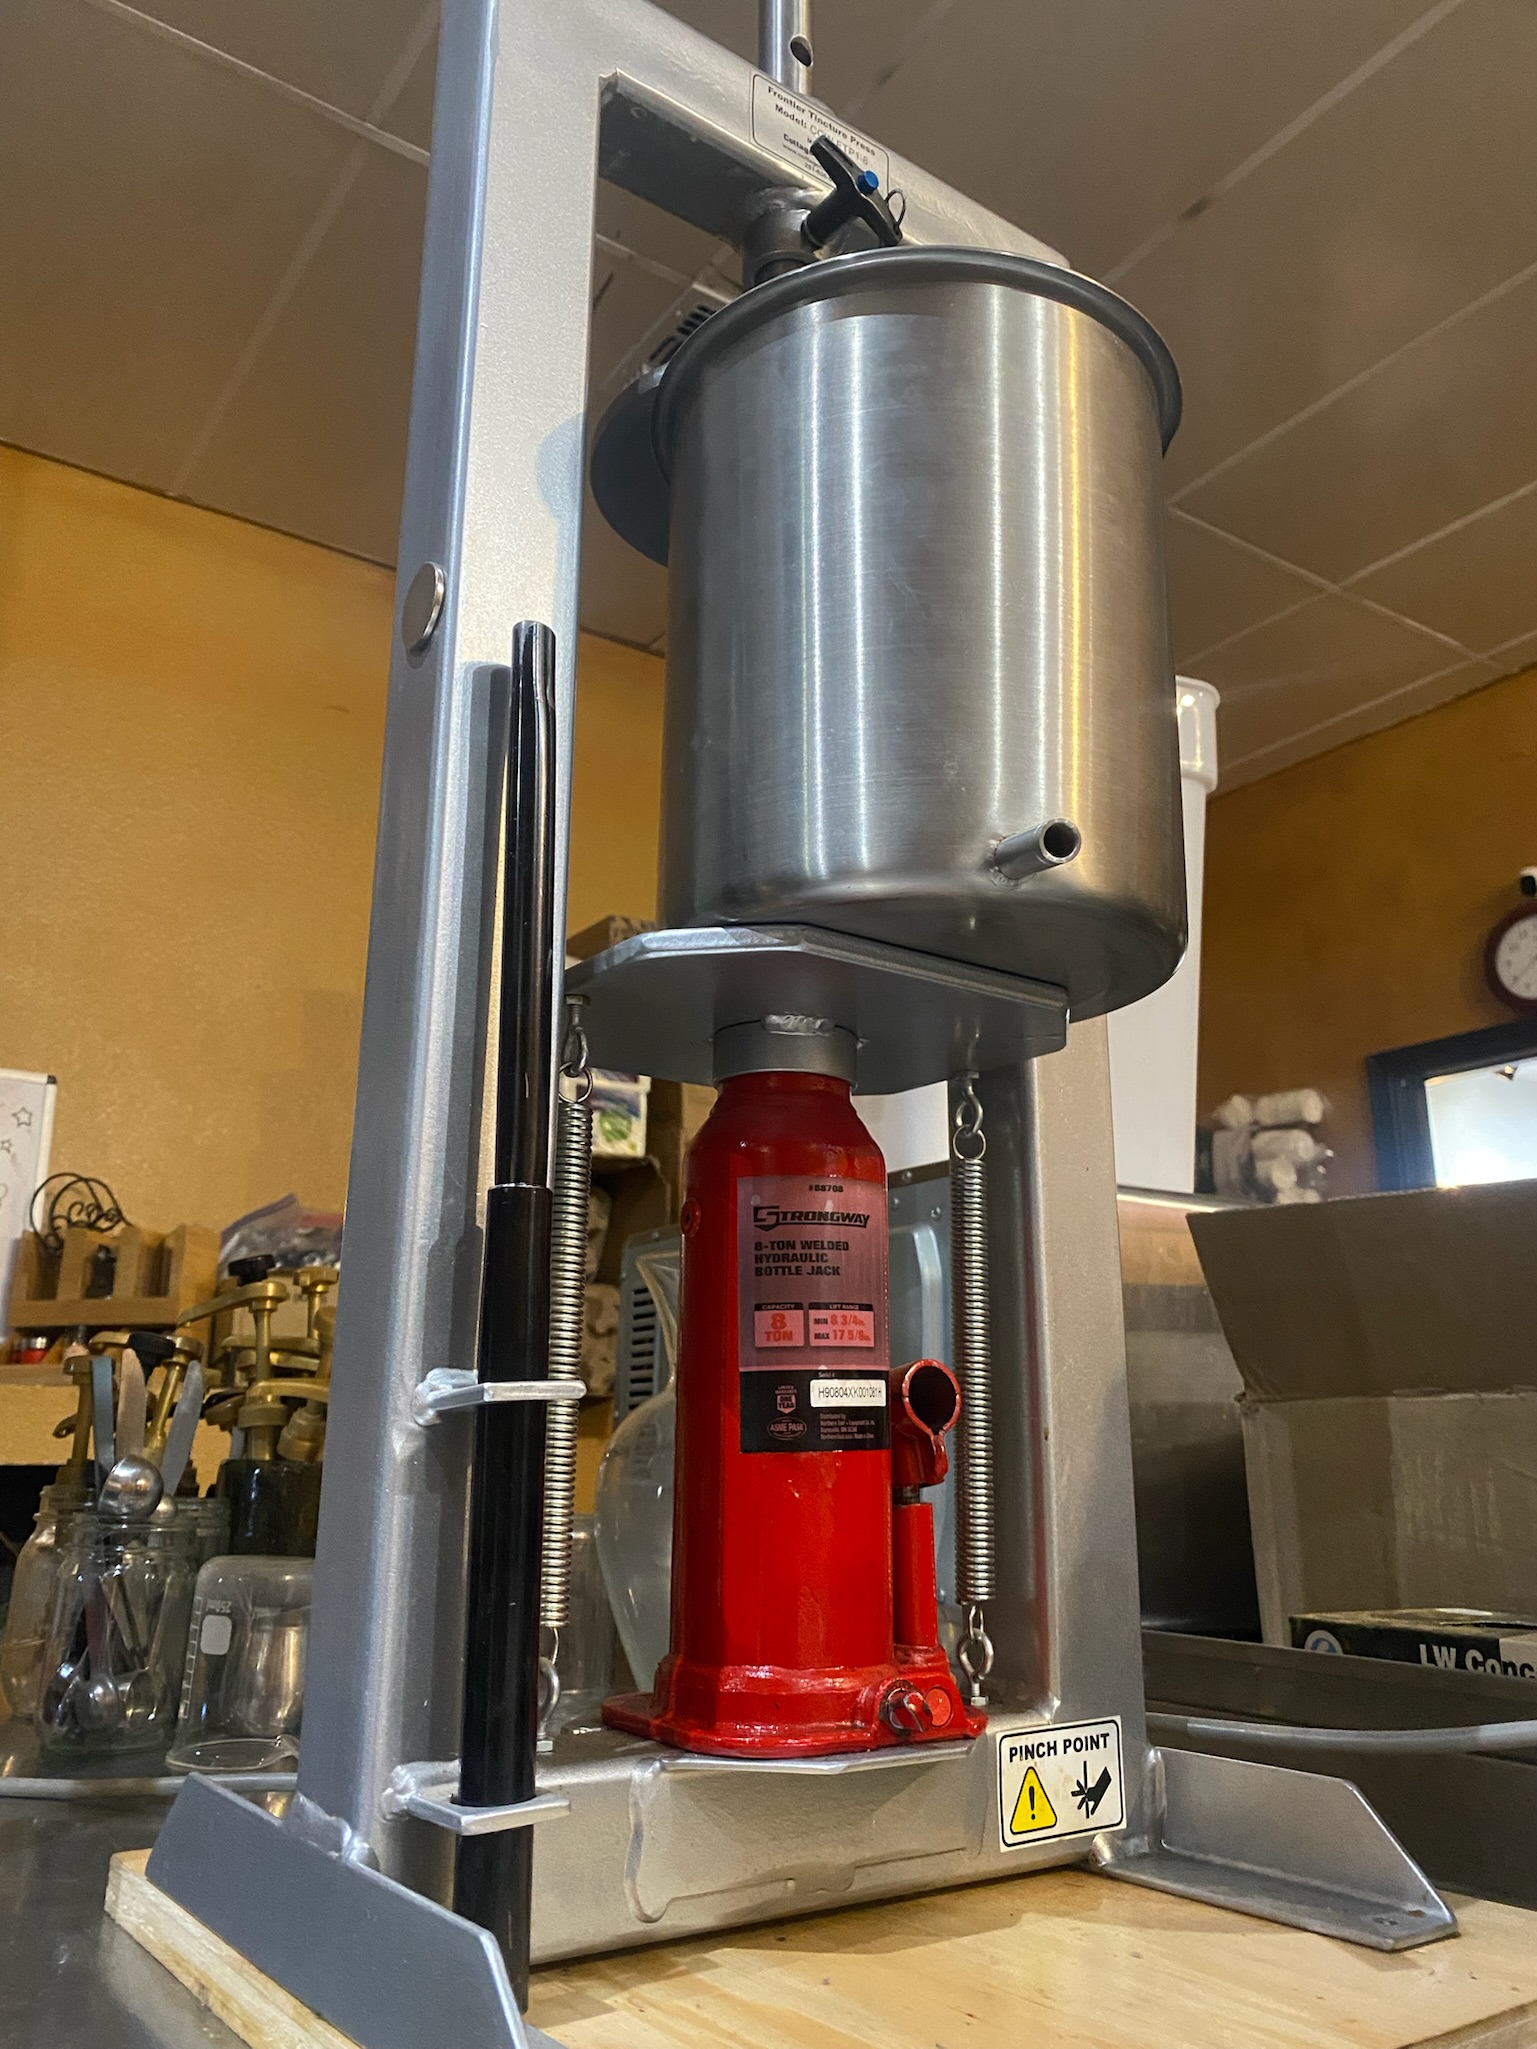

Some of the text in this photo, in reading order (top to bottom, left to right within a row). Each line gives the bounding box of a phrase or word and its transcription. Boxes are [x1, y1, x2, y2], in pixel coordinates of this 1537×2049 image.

[767, 86, 806, 115] Frontier
[808, 110, 848, 140] Tincture
[850, 135, 876, 157] Press
[775, 103, 807, 129] Model:
[783, 133, 811, 155] Cottag
[753, 1205, 870, 1231] STRONGWAY
[754, 1240, 849, 1251] 8-TON WELDED
[754, 1253, 829, 1264] HYDRAULIC
[754, 1266, 841, 1277] BOTTLE JACK
[770, 1313, 787, 1330] 8
[830, 1314, 838, 1326] 8
[764, 1331, 793, 1342] TON
[832, 1330, 845, 1340] 17
[1419, 1644, 1456, 1670] LW
[1009, 1733, 1110, 1763] PINCH POINT
